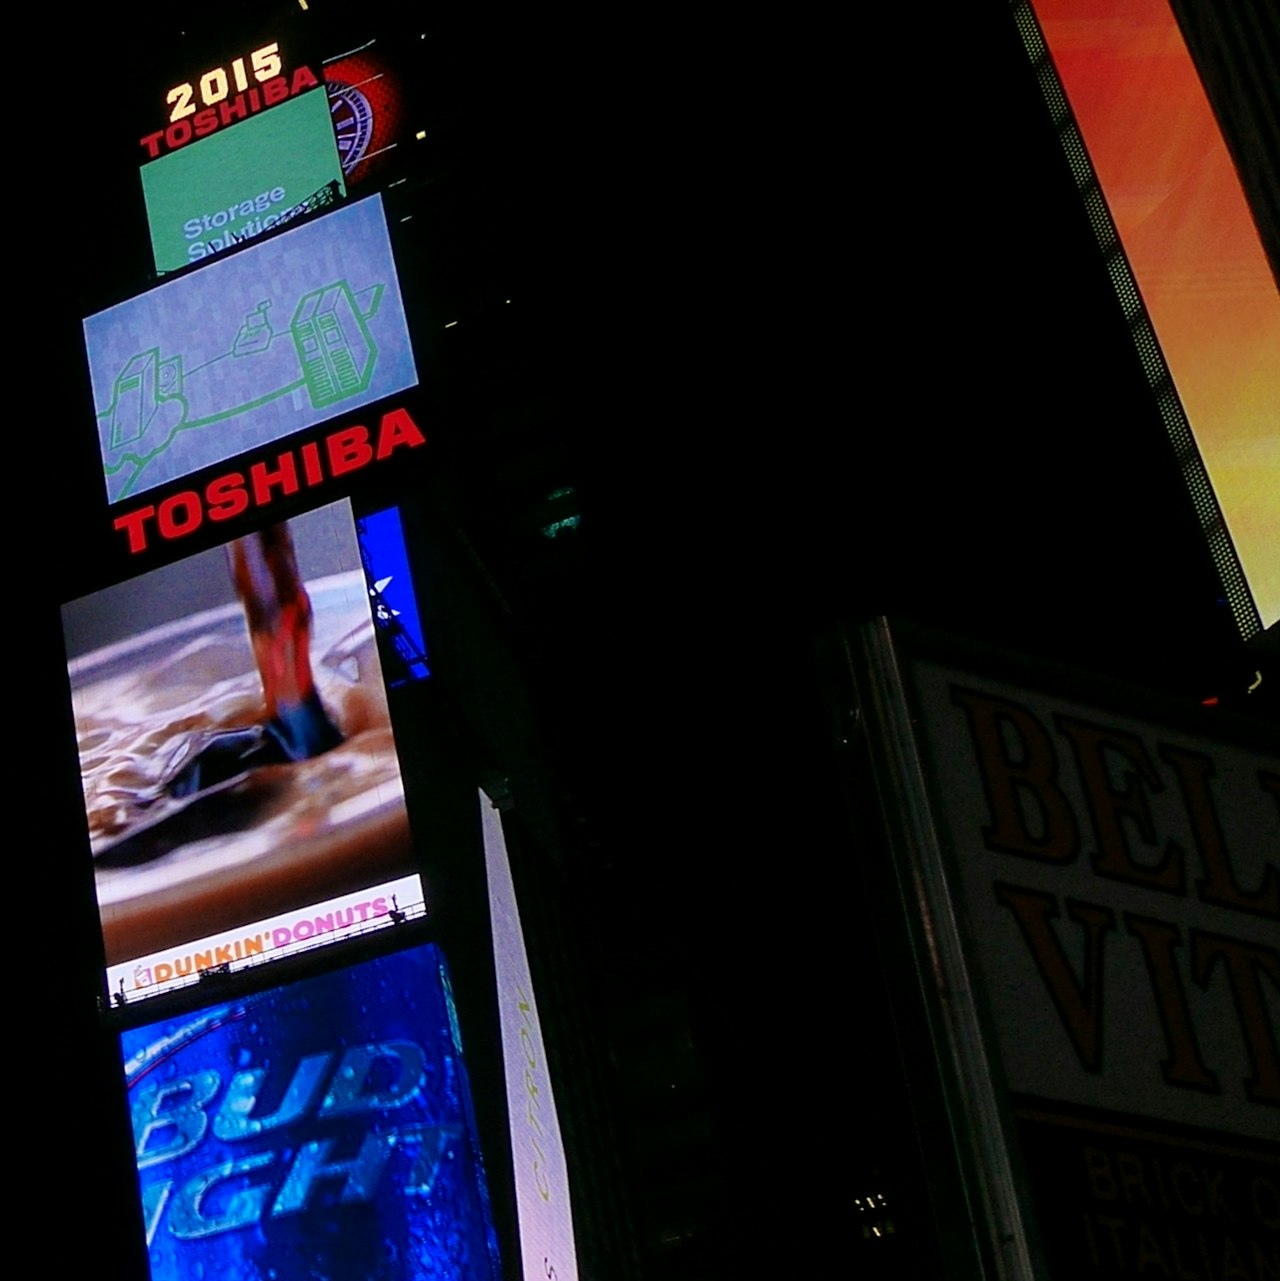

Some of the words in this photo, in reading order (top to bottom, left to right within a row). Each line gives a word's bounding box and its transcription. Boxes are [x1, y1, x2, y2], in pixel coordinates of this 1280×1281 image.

[141, 64, 318, 158] TOSHIBA
[167, 42, 283, 122] 2015
[184, 186, 285, 239] Storage
[114, 407, 426, 553] TOSHIBA
[154, 933, 273, 984] DUNKIN'
[272, 896, 390, 949] DONUTS
[133, 1040, 426, 1168] BUD
[1083, 1145, 1237, 1222] BRICK
